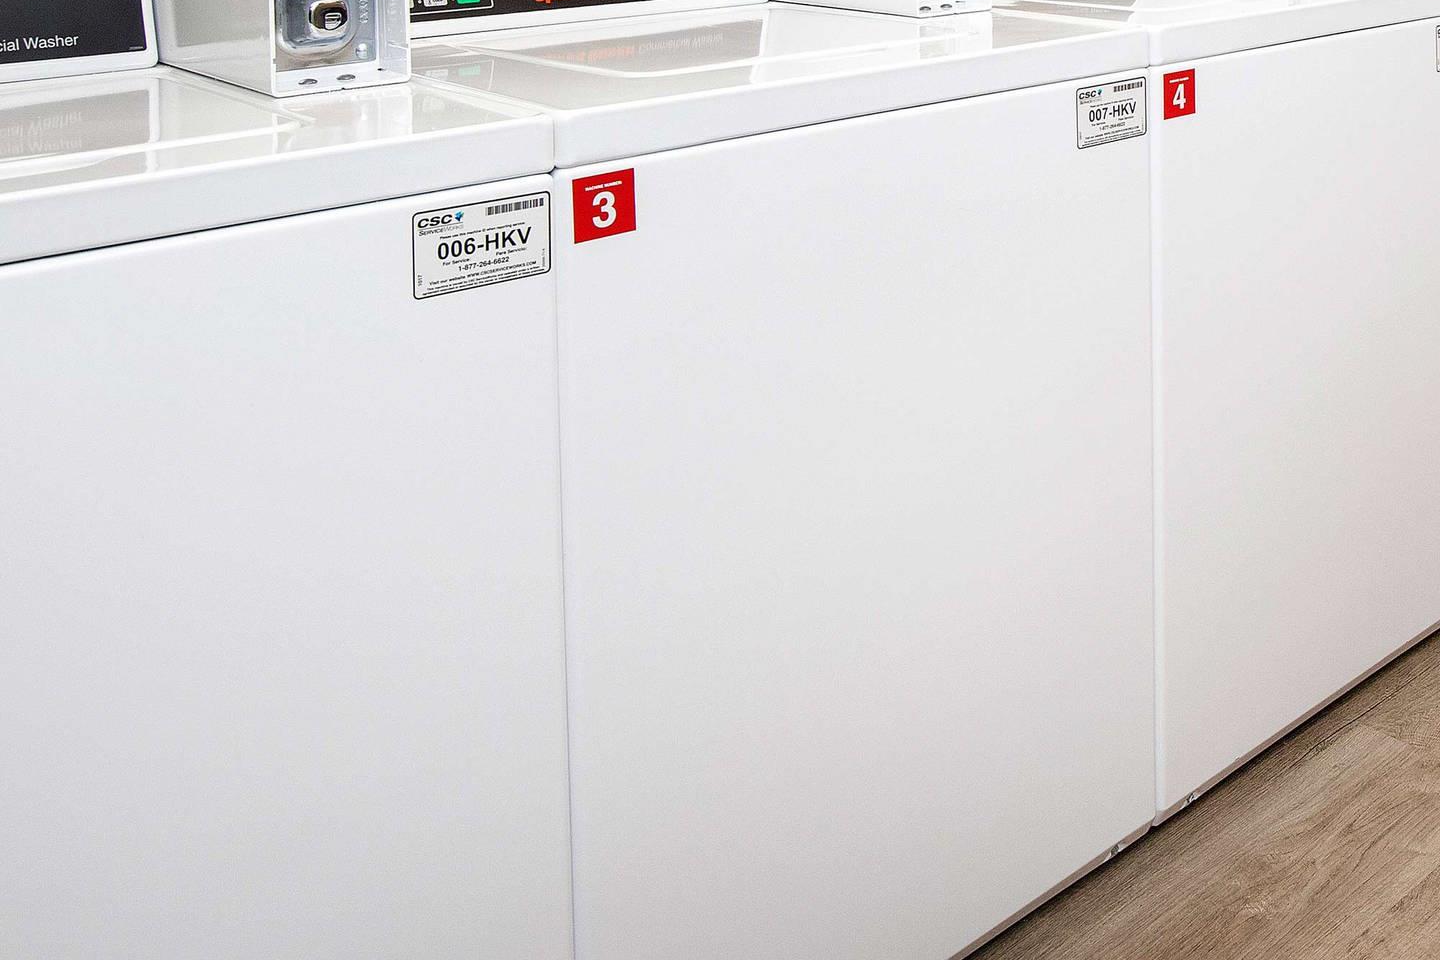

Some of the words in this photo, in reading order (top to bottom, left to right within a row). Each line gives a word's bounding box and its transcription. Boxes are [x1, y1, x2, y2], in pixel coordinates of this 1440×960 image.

[23, 35, 79, 50] Washer
[1078, 89, 1096, 100] CSC
[1172, 83, 1187, 110] 4
[1088, 100, 1136, 123] 007-HKV
[416, 213, 453, 229] CSC
[592, 190, 617, 229] 3
[437, 226, 532, 260] 006-HKV
